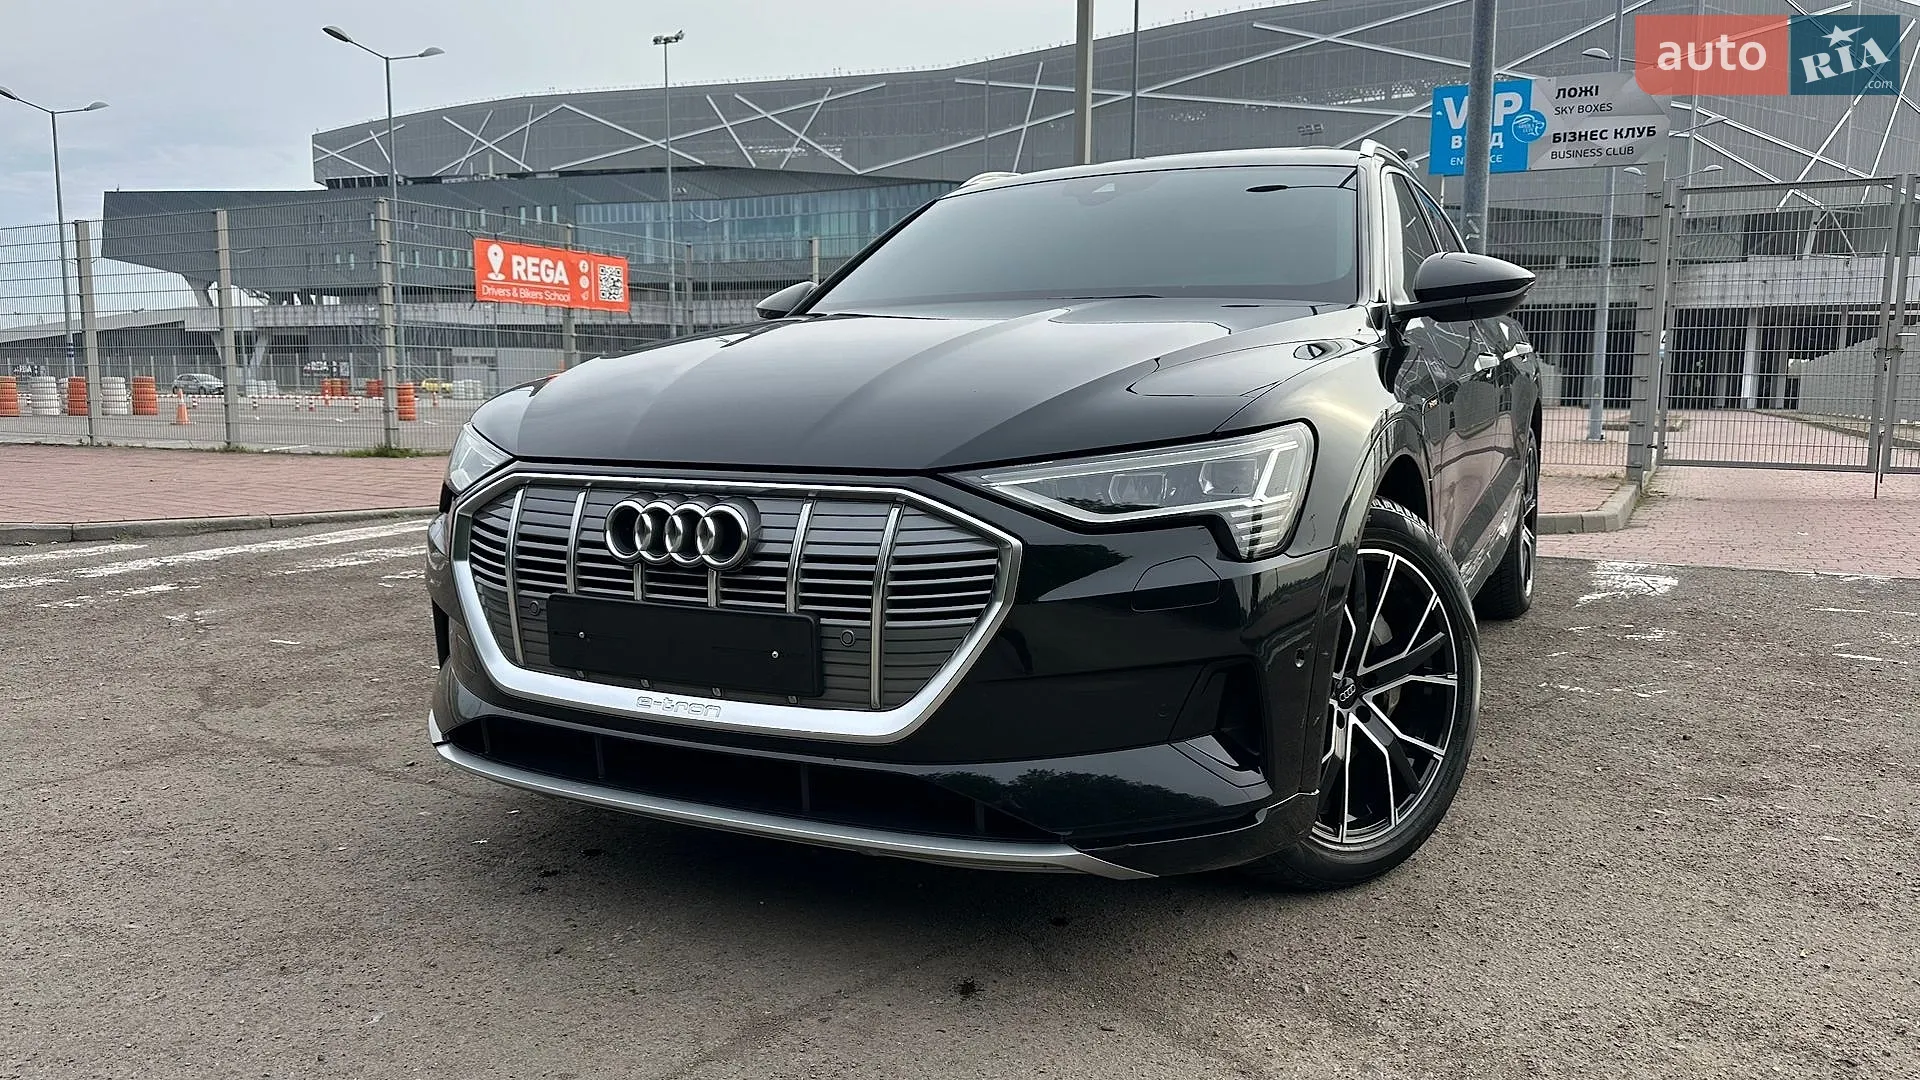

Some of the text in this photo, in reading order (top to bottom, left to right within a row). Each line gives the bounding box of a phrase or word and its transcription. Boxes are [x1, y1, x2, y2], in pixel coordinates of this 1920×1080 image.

[1555, 85, 1600, 100] ЛОЖІ
[1443, 92, 1523, 130] VP
[1554, 102, 1613, 116] SKY BOXES
[1451, 132, 1504, 149] ВД
[1552, 125, 1657, 144] БІЗНЕС КЛУБ
[1550, 146, 1634, 160] BUSINESS CLUB
[511, 254, 570, 285] REGA
[482, 285, 571, 303] Drivers & Bikers School
[636, 695, 722, 718] e-tron
